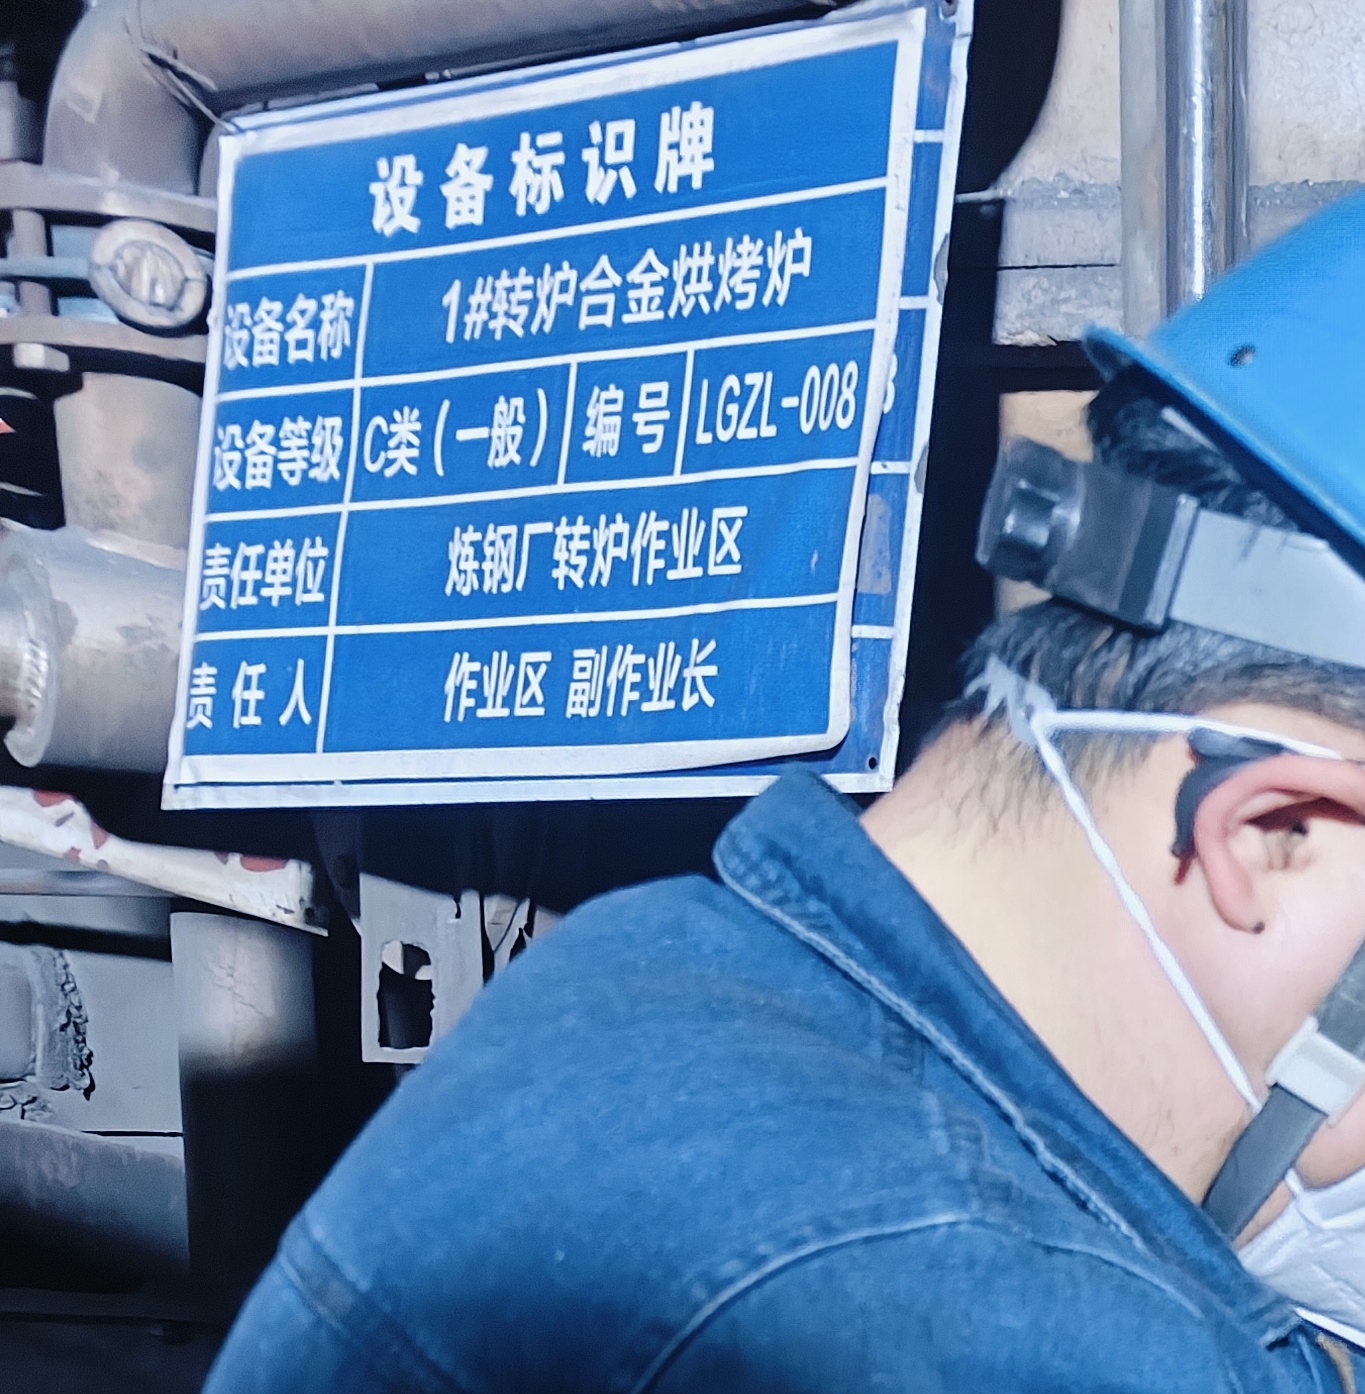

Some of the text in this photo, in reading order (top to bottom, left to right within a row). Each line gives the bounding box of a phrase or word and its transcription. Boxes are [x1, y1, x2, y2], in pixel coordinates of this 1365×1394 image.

[370, 103, 716, 236] 设备标识牌
[224, 228, 811, 368] 设备名称 1#转炉合金烘烤炉
[214, 416, 343, 490] 设备等级
[583, 382, 670, 457] 编号
[696, 361, 858, 444] LGZL-008
[198, 508, 744, 612] 责任单位 炼钢厂转炉作业区
[185, 660, 312, 731] 责任人
